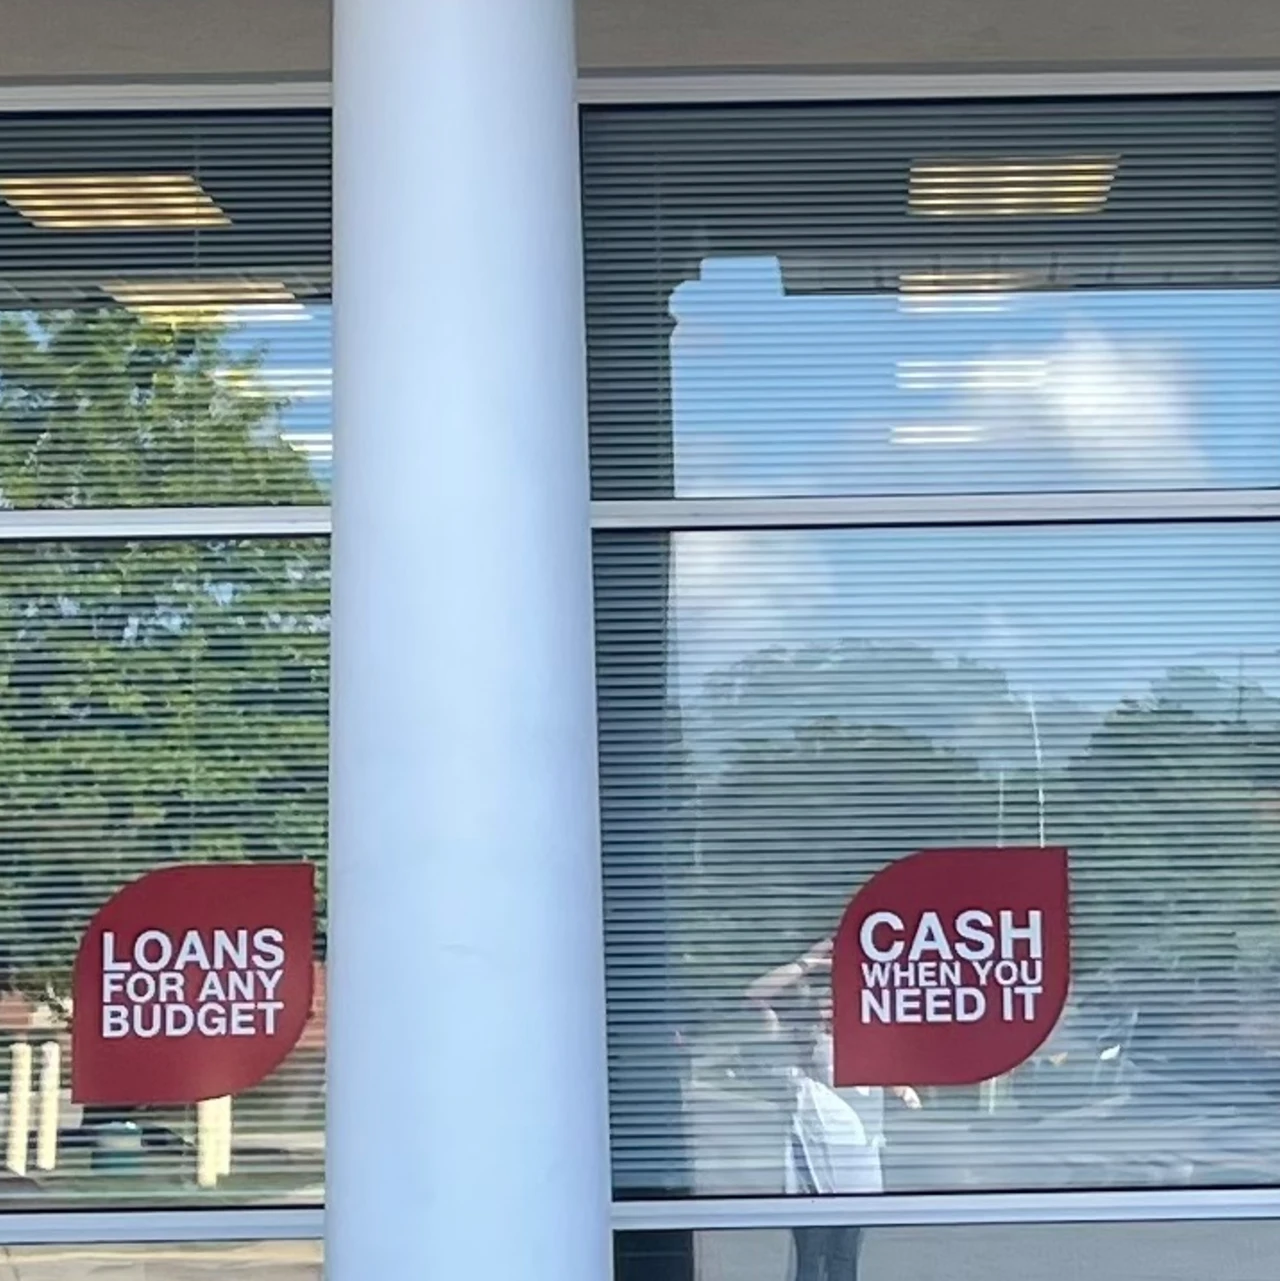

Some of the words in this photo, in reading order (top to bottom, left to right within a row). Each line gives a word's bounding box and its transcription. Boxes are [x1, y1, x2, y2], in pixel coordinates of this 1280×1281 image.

[102, 928, 285, 972] LOANS
[859, 910, 1043, 962] CASH
[102, 971, 185, 1003] FOR
[197, 970, 284, 1001] ANY
[860, 961, 962, 988] WHEN
[972, 960, 1043, 986] YOU
[102, 1001, 285, 1039] BUDGET
[860, 988, 987, 1024] NEED
[1002, 986, 1043, 1022] IT
